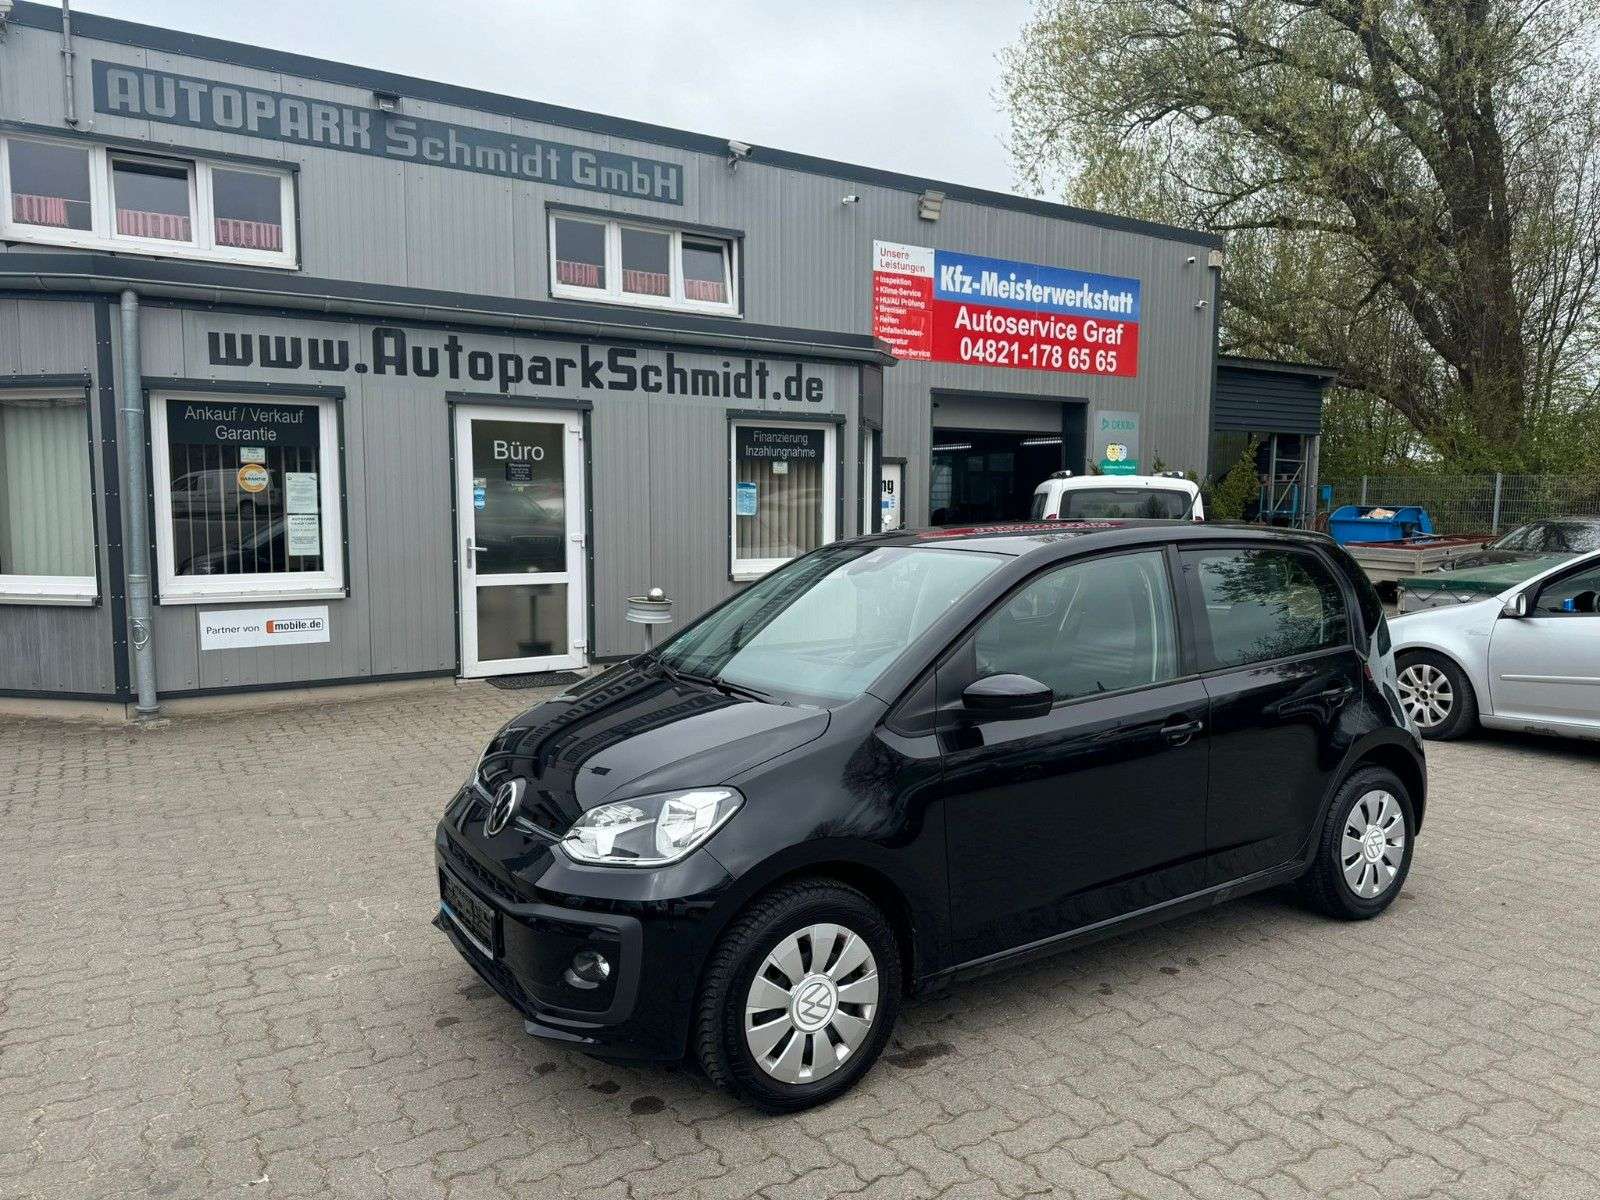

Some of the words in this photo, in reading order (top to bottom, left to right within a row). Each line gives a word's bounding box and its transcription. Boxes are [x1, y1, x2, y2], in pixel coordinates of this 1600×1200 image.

[106, 68, 371, 149] AUTOPARK
[385, 118, 561, 180] Schmidt
[571, 149, 677, 200] GmbH
[880, 248, 909, 259] Unsere
[880, 260, 926, 273] Leistungen
[940, 264, 1133, 314] Kfz-Meisterwerkstatt
[954, 306, 1078, 341] Autoservice
[1083, 320, 1124, 345] Graf
[960, 336, 1063, 368] 04821-178
[1068, 348, 1090, 371] 65
[1095, 350, 1118, 373] 65
[208, 327, 824, 403] www.AutoparkSchmidt.de
[184, 405, 238, 421] Ankauf
[249, 408, 304, 423] Verkauf
[215, 425, 277, 441] Garantie
[753, 430, 808, 446] Finanzierung
[493, 440, 545, 461] Büro
[745, 444, 816, 458] Inzahlungnahme
[206, 625, 240, 635] Partner
[243, 625, 260, 633] von
[274, 618, 321, 631] mobile.de
